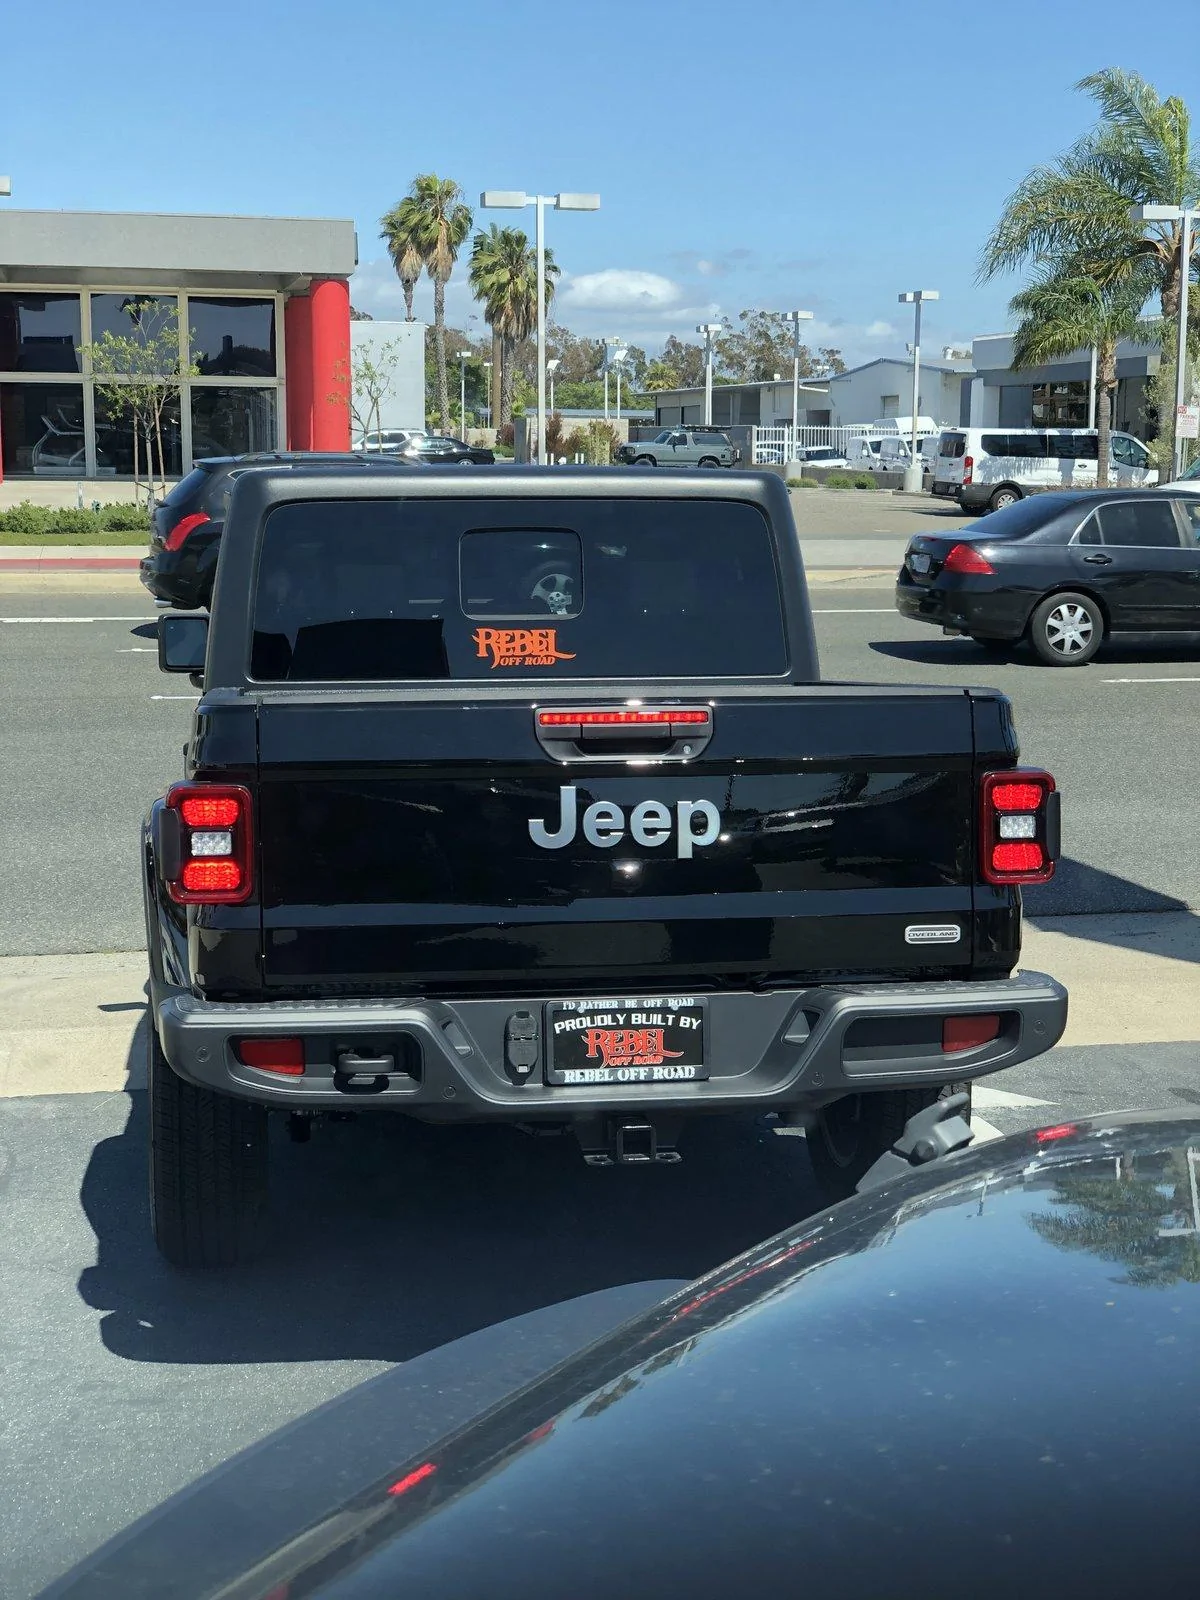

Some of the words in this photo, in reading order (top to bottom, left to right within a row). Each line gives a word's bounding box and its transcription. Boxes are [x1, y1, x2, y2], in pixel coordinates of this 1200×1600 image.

[471, 628, 577, 669] REBEL
[500, 657, 522, 665] OFF
[525, 657, 555, 665] ROAD
[528, 785, 721, 859] Jeep
[580, 1000, 618, 1009] RATHER
[625, 999, 637, 1008] BE
[643, 999, 663, 1008] OFF
[668, 998, 694, 1007] ROAD
[554, 1013, 627, 1034] PROUDLY
[631, 1013, 676, 1026] BUILT
[679, 1015, 702, 1030] BY
[581, 1028, 684, 1069] REBEL
[564, 1068, 613, 1083] REBEL
[617, 1067, 649, 1081] OFF
[653, 1066, 696, 1080] ROAD
